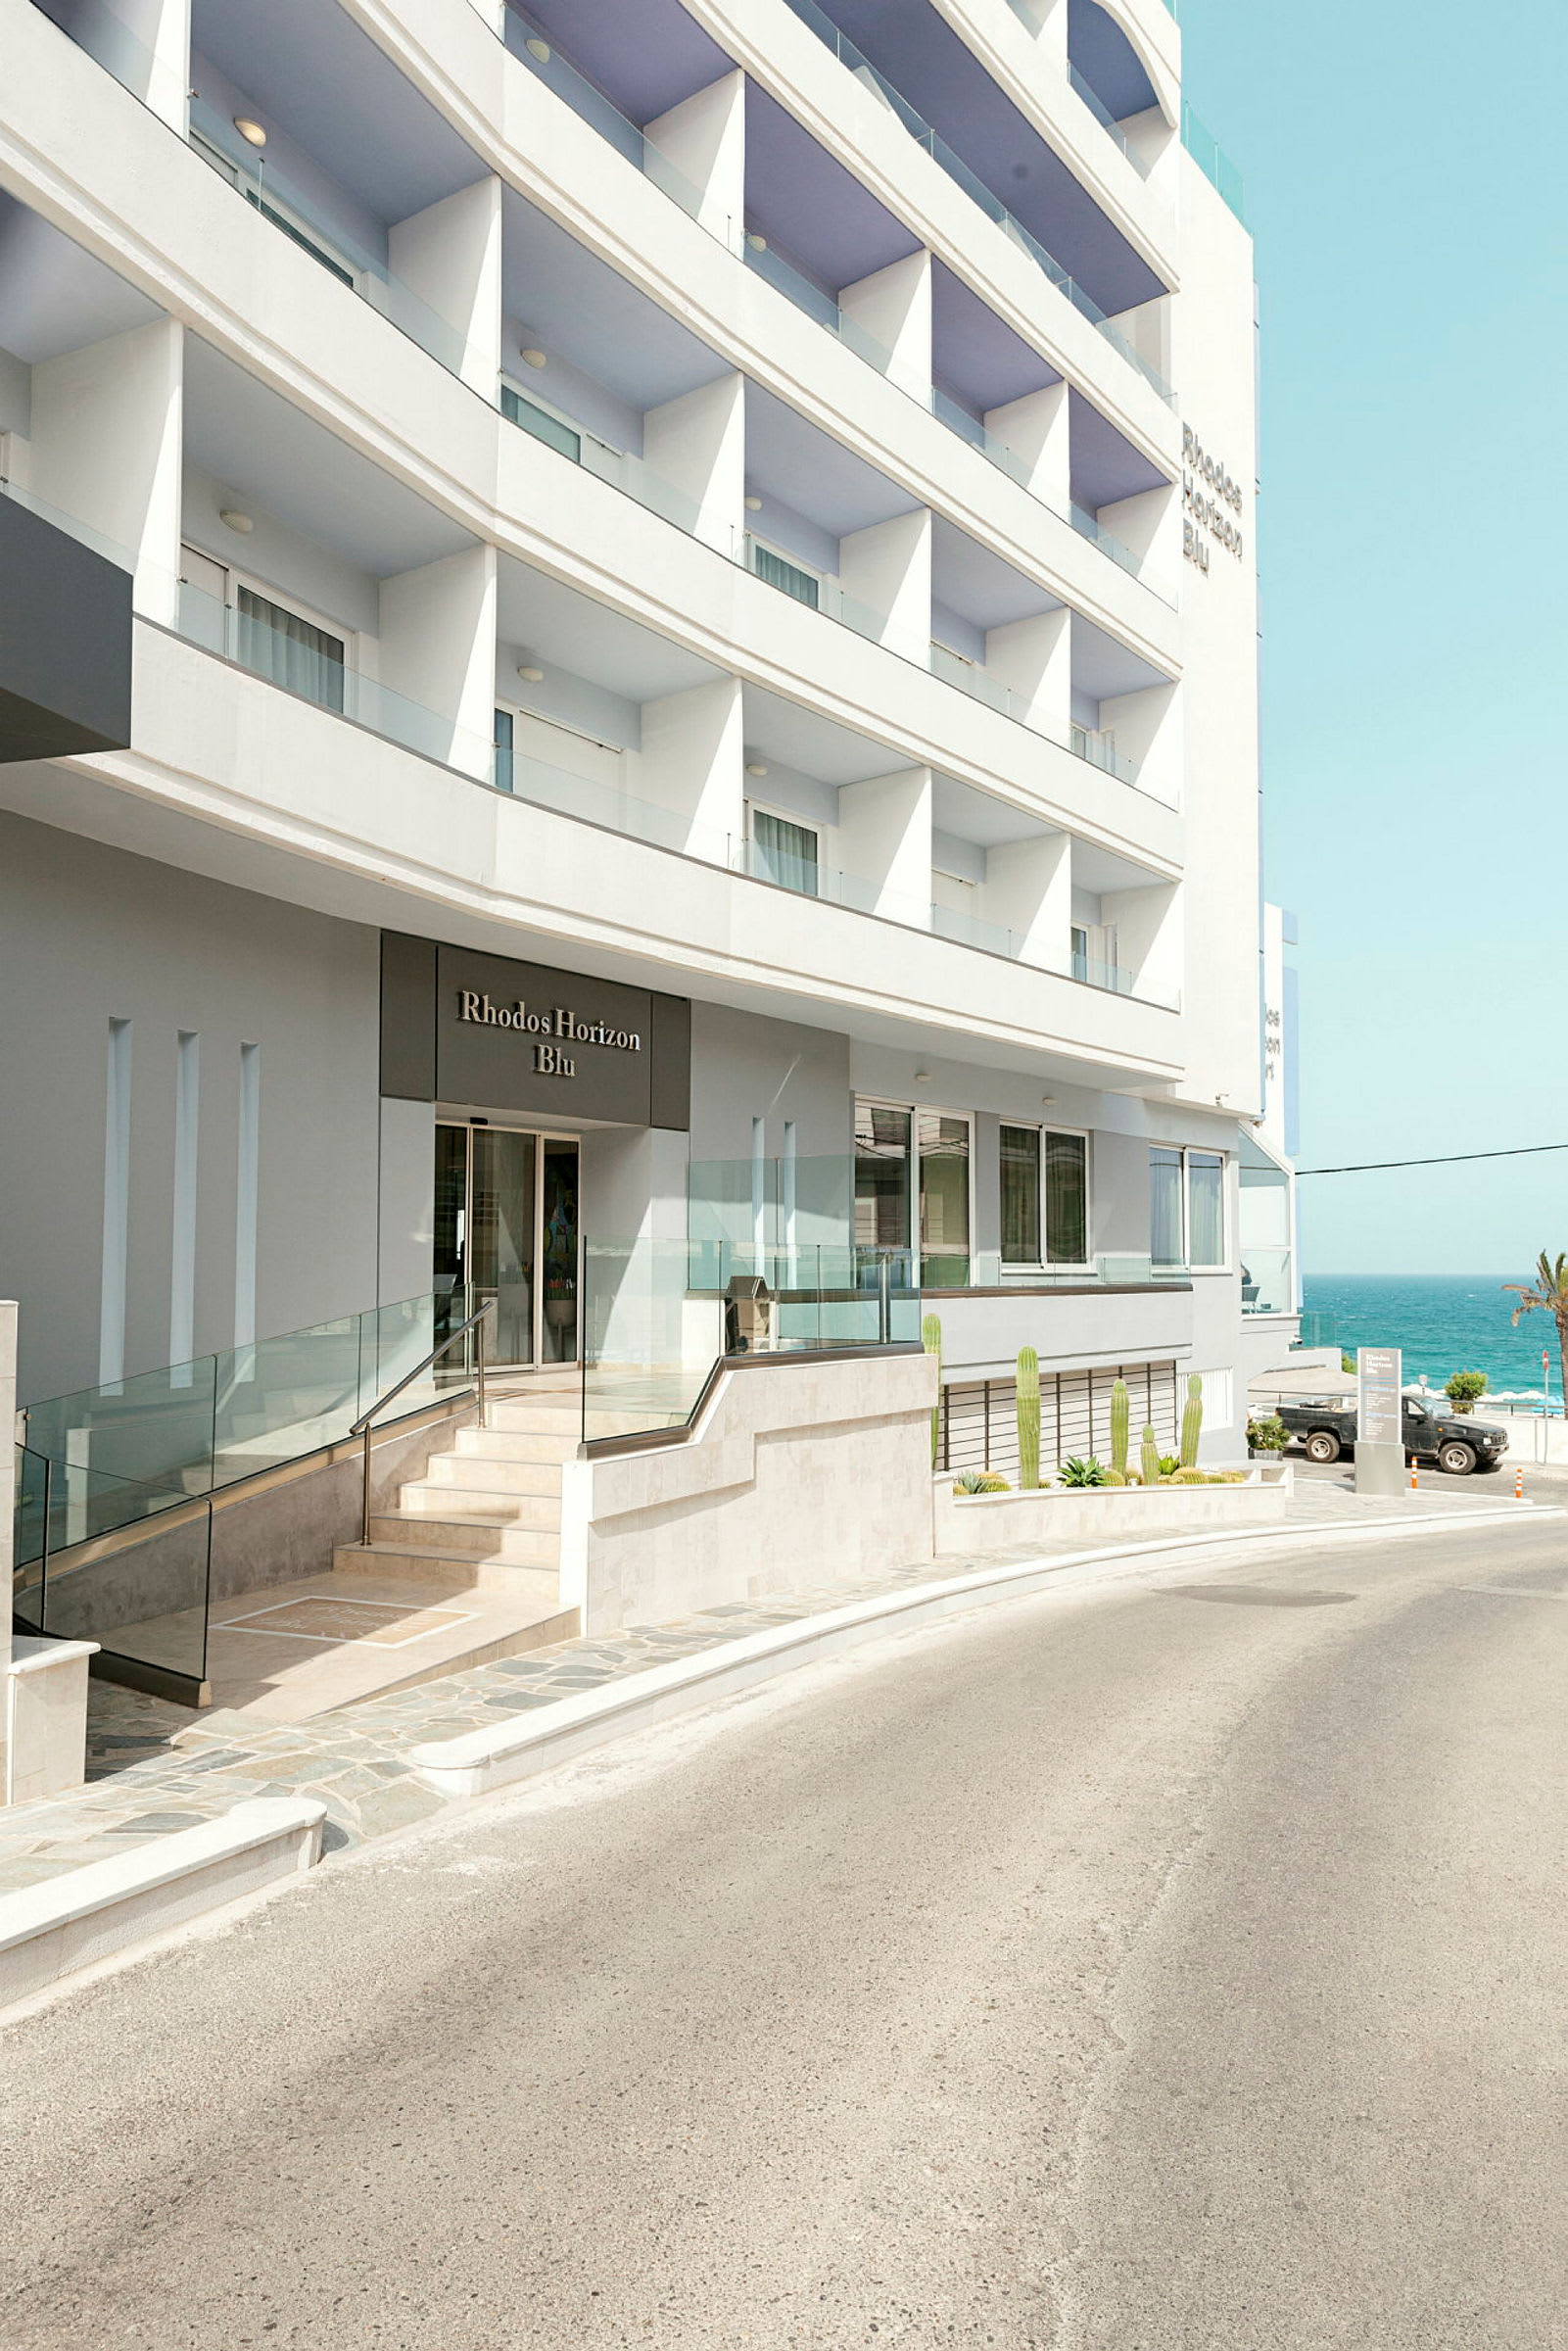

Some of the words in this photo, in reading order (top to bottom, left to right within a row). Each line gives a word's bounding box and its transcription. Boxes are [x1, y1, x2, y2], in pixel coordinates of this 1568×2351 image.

[1181, 421, 1243, 514] Rhodos
[1181, 469, 1243, 560] Horizon
[1182, 517, 1210, 576] Blu
[459, 989, 550, 1034] Rhodos
[553, 1007, 641, 1051] Horizon
[534, 1043, 576, 1077] Blu
